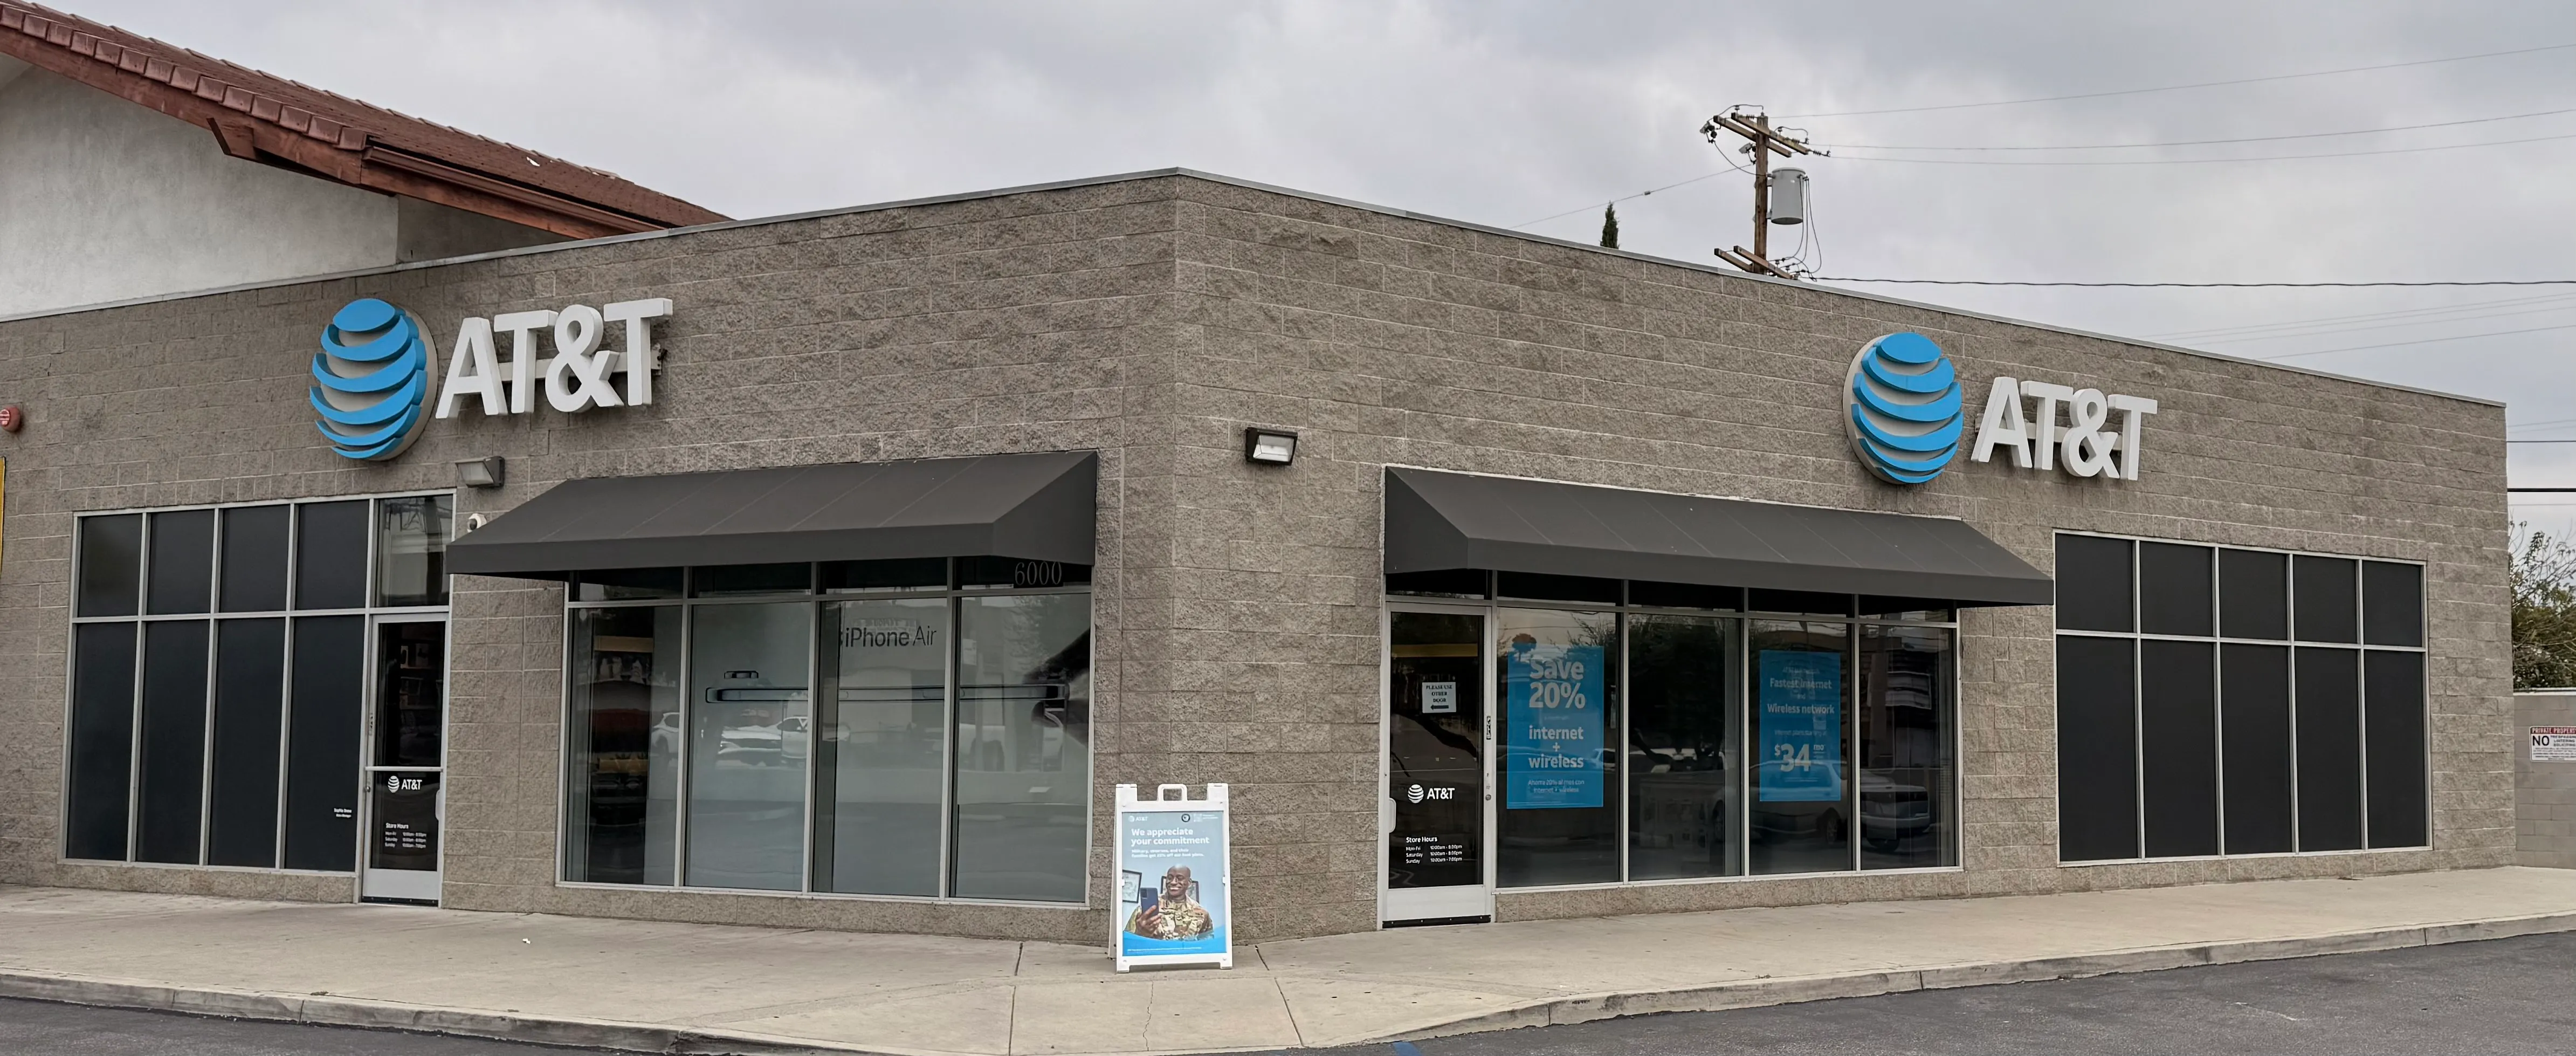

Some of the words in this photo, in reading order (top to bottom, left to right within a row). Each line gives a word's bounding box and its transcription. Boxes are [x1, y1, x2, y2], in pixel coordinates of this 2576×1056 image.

[436, 298, 673, 419] AT&T
[1971, 377, 2158, 481] AT&T
[1014, 561, 1062, 585] 6000
[845, 627, 910, 647] iPhone
[913, 626, 937, 646] Air
[1530, 659, 1584, 680] Save
[1770, 678, 1799, 688] Fastest
[1801, 678, 1832, 689] Internet
[1529, 682, 1586, 709] 20%
[1767, 703, 1800, 714] Wireless
[1802, 704, 1835, 714] network
[1529, 724, 1584, 739] internet
[2532, 736, 2550, 746] NO
[1528, 753, 1584, 769] wireless
[1774, 743, 1812, 772] $34
[401, 779, 422, 790] AT&T
[1427, 788, 1455, 799] AT&T
[1147, 827, 1193, 837] appreciate
[1131, 839, 1152, 847] your
[1153, 836, 1210, 845] commitment
